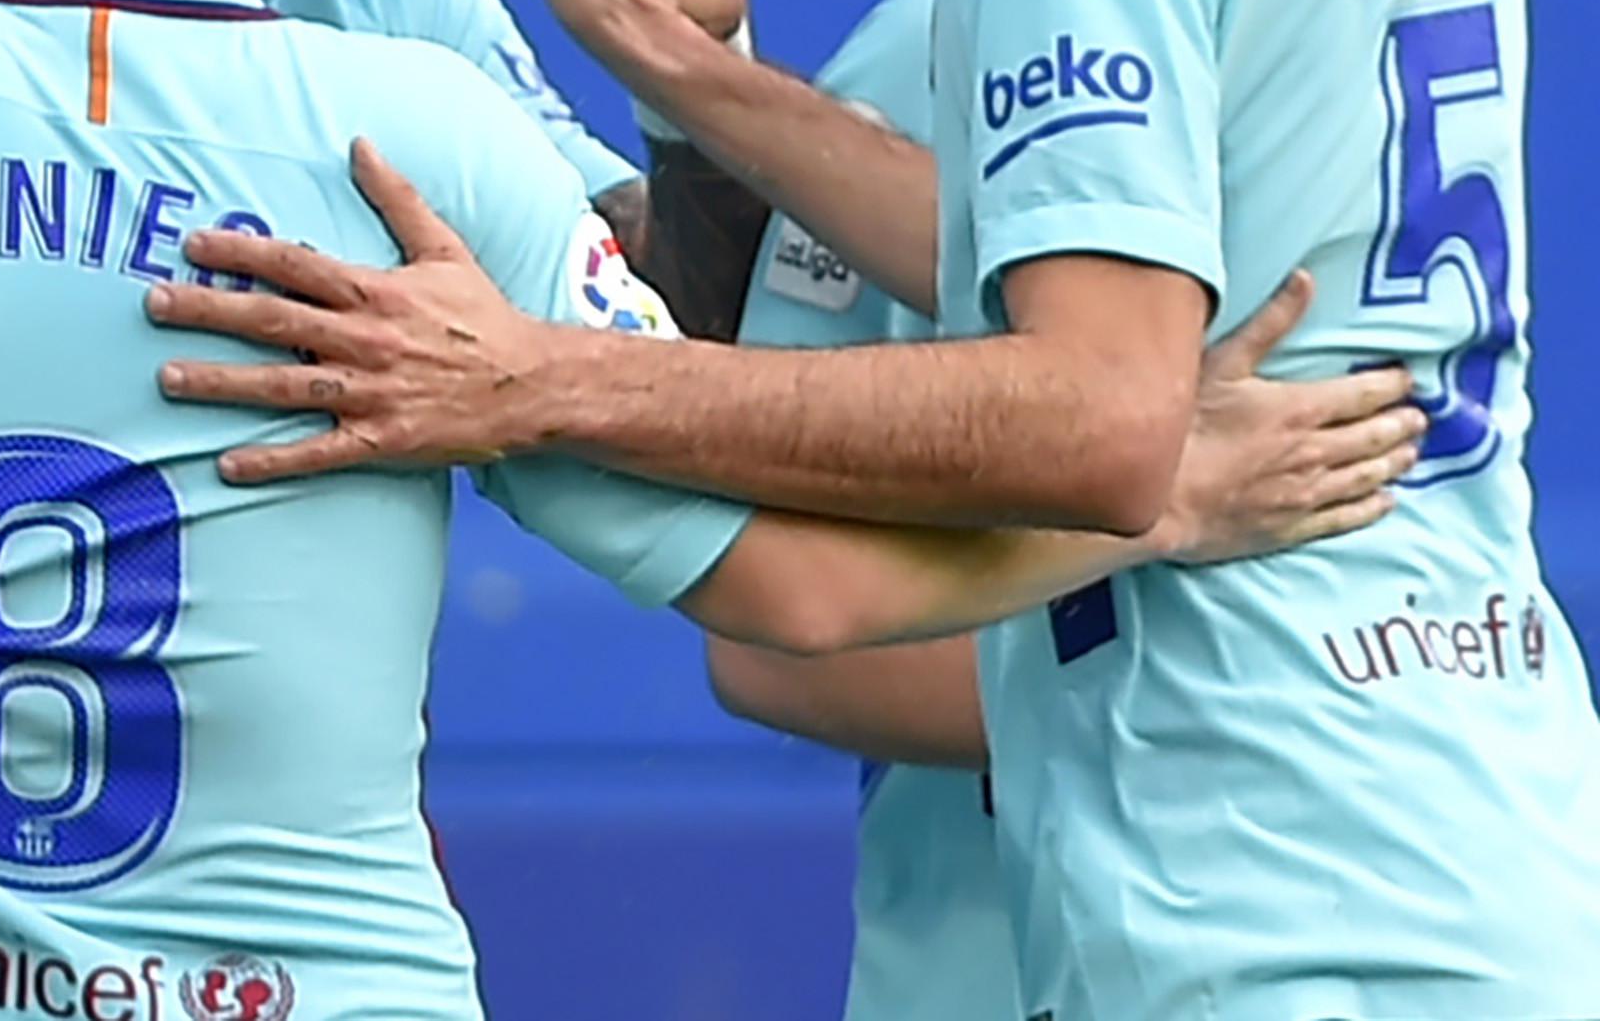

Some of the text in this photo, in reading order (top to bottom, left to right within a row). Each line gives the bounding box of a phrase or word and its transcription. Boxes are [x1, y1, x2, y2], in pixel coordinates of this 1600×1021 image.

[982, 35, 1153, 132] beko
[1352, 1, 1517, 489] 5
[1321, 592, 1511, 686] unicef
